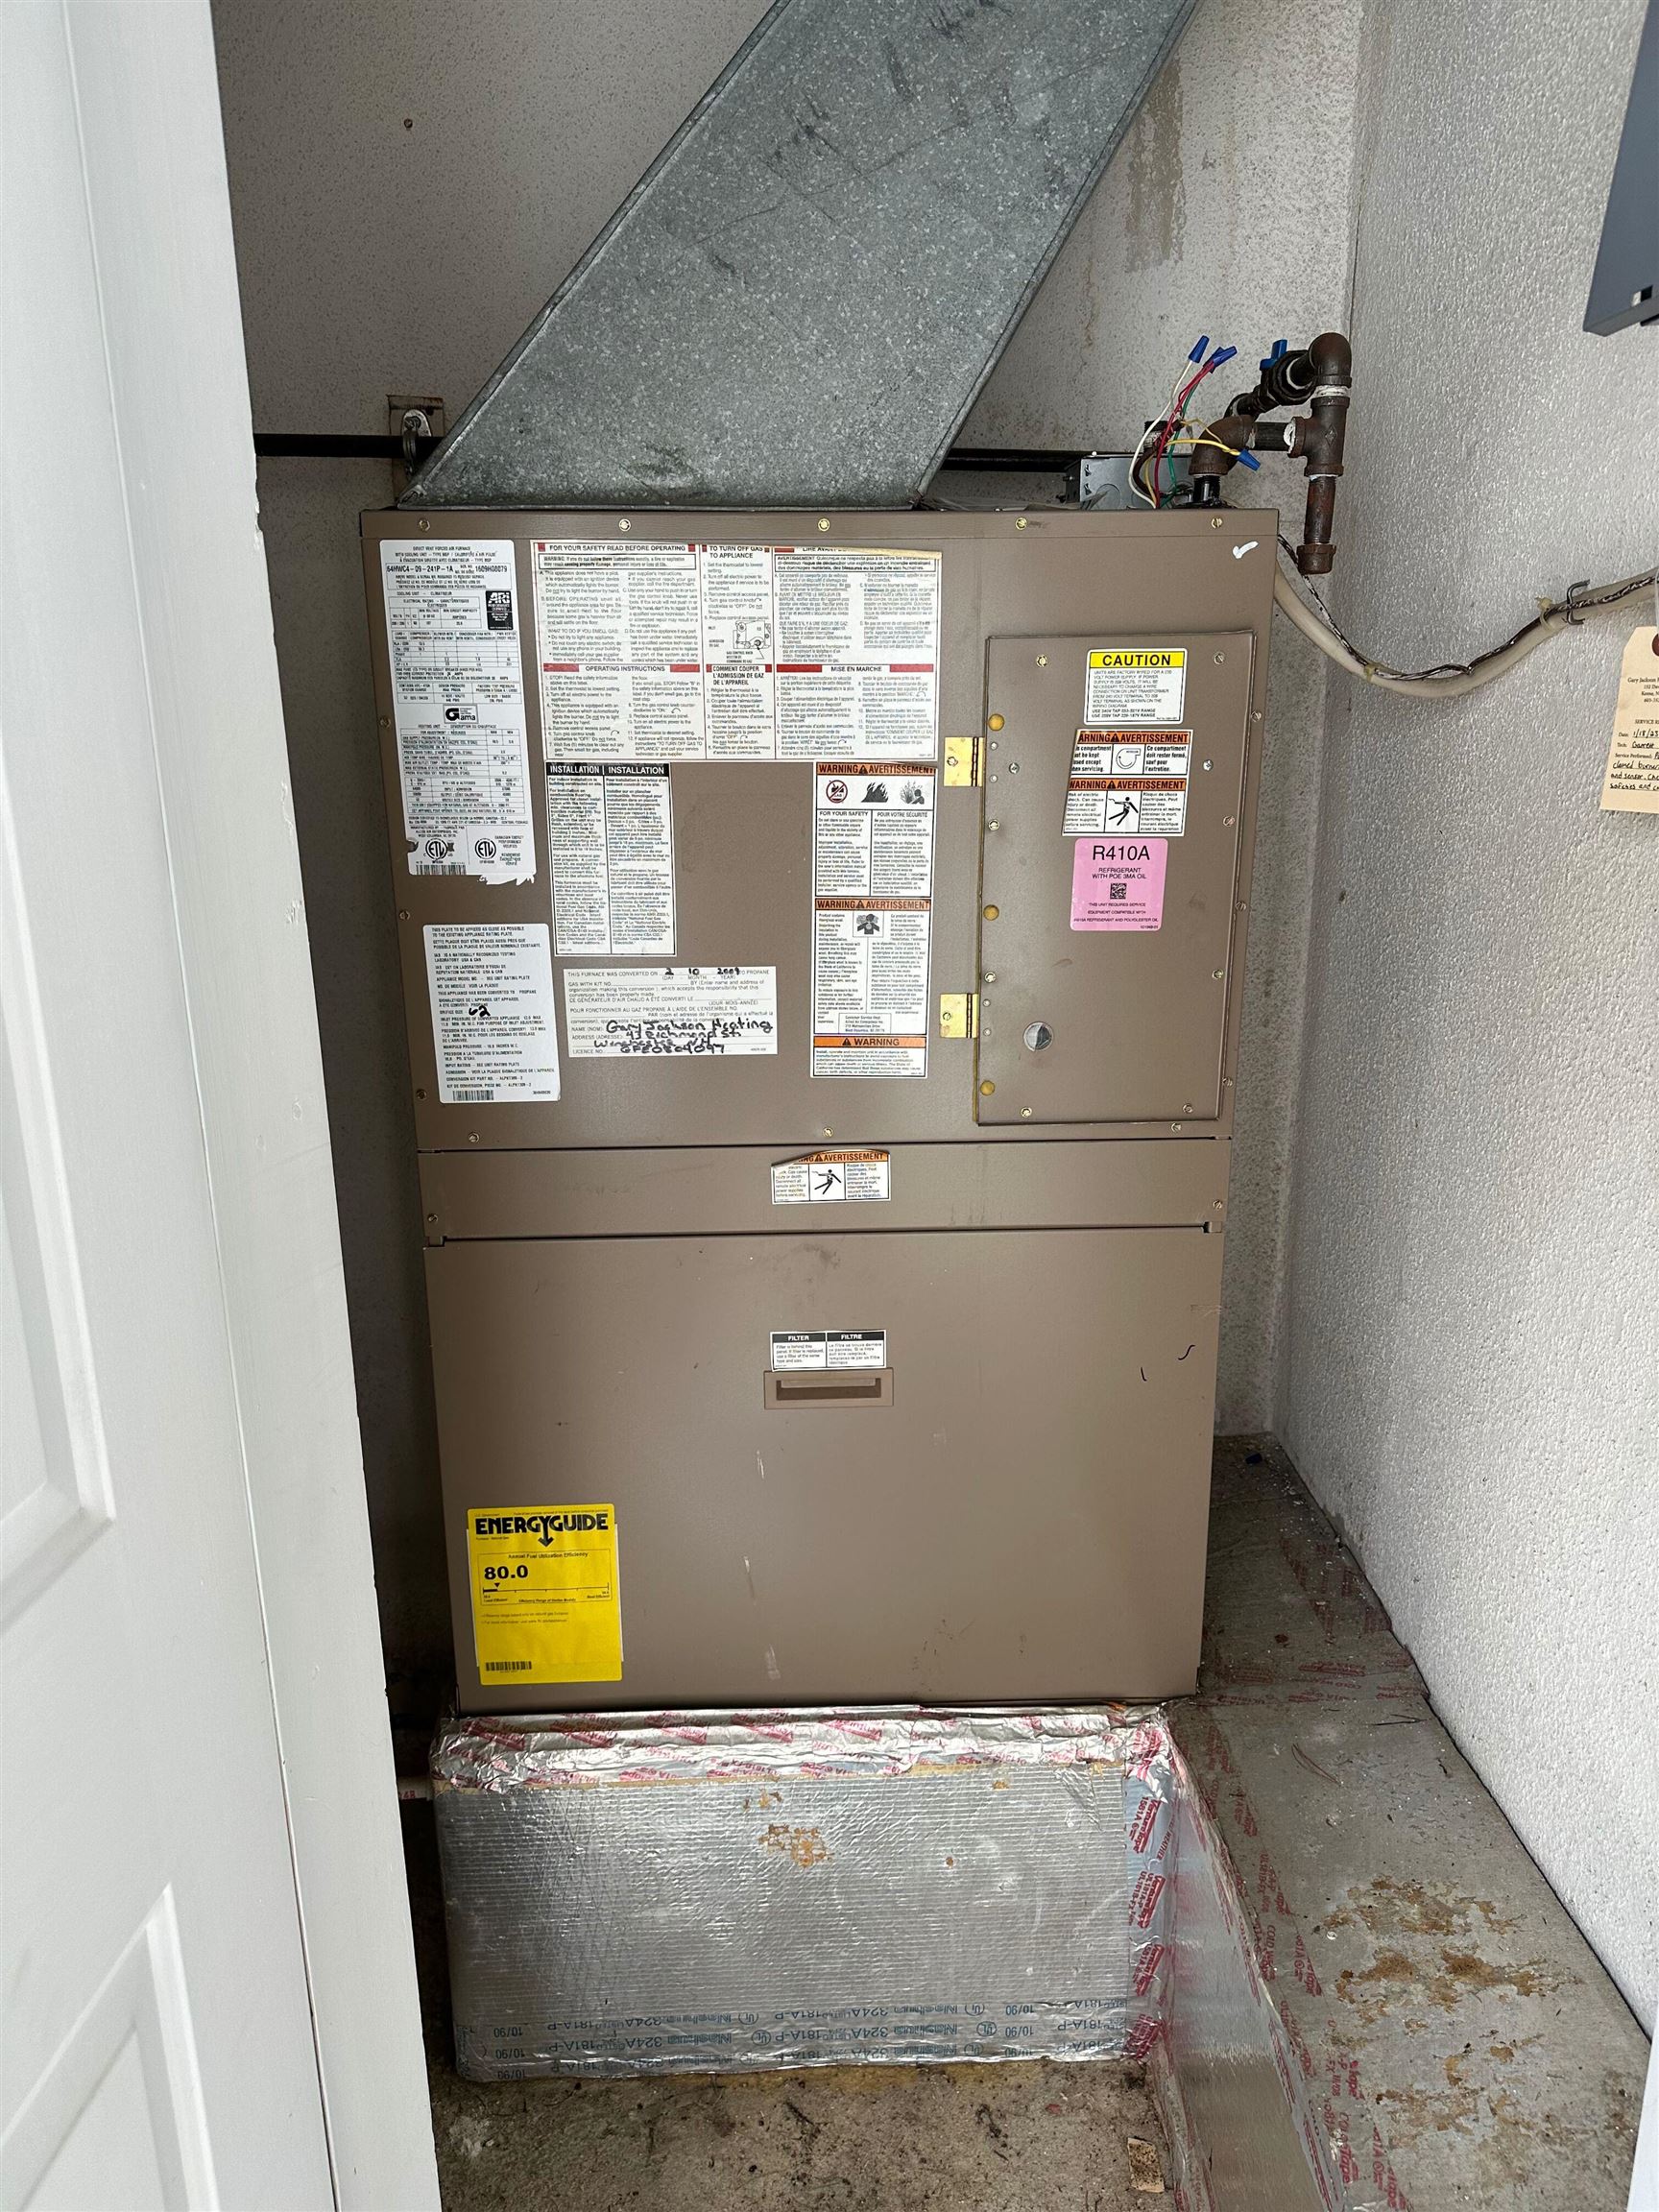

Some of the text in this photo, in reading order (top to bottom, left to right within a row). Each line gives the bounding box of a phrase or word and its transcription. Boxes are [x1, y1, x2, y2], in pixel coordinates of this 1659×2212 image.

[1103, 655, 1170, 666] CAUTION
[1078, 734, 1188, 742] ARNING AVERTISSEMENT
[819, 765, 858, 773] WARNING
[1069, 780, 1184, 789] WARNING AVERTISSEMENT
[1093, 845, 1150, 860] R410A
[606, 1017, 773, 1033] Gary Jackson Heating
[824, 1153, 883, 1162] AVERTISSEMENT
[476, 1513, 608, 1534] ENERGYGUIDE
[484, 1565, 528, 1580] 80.0
[1005, 2004, 1035, 2016] 10/90
[493, 2026, 522, 2038] 10/90
[775, 2019, 1102, 2042] 181A-P 10/90 Nashua 324A 181A-P
[495, 2032, 731, 2059] Nashua 324A 181A-P 10/90
